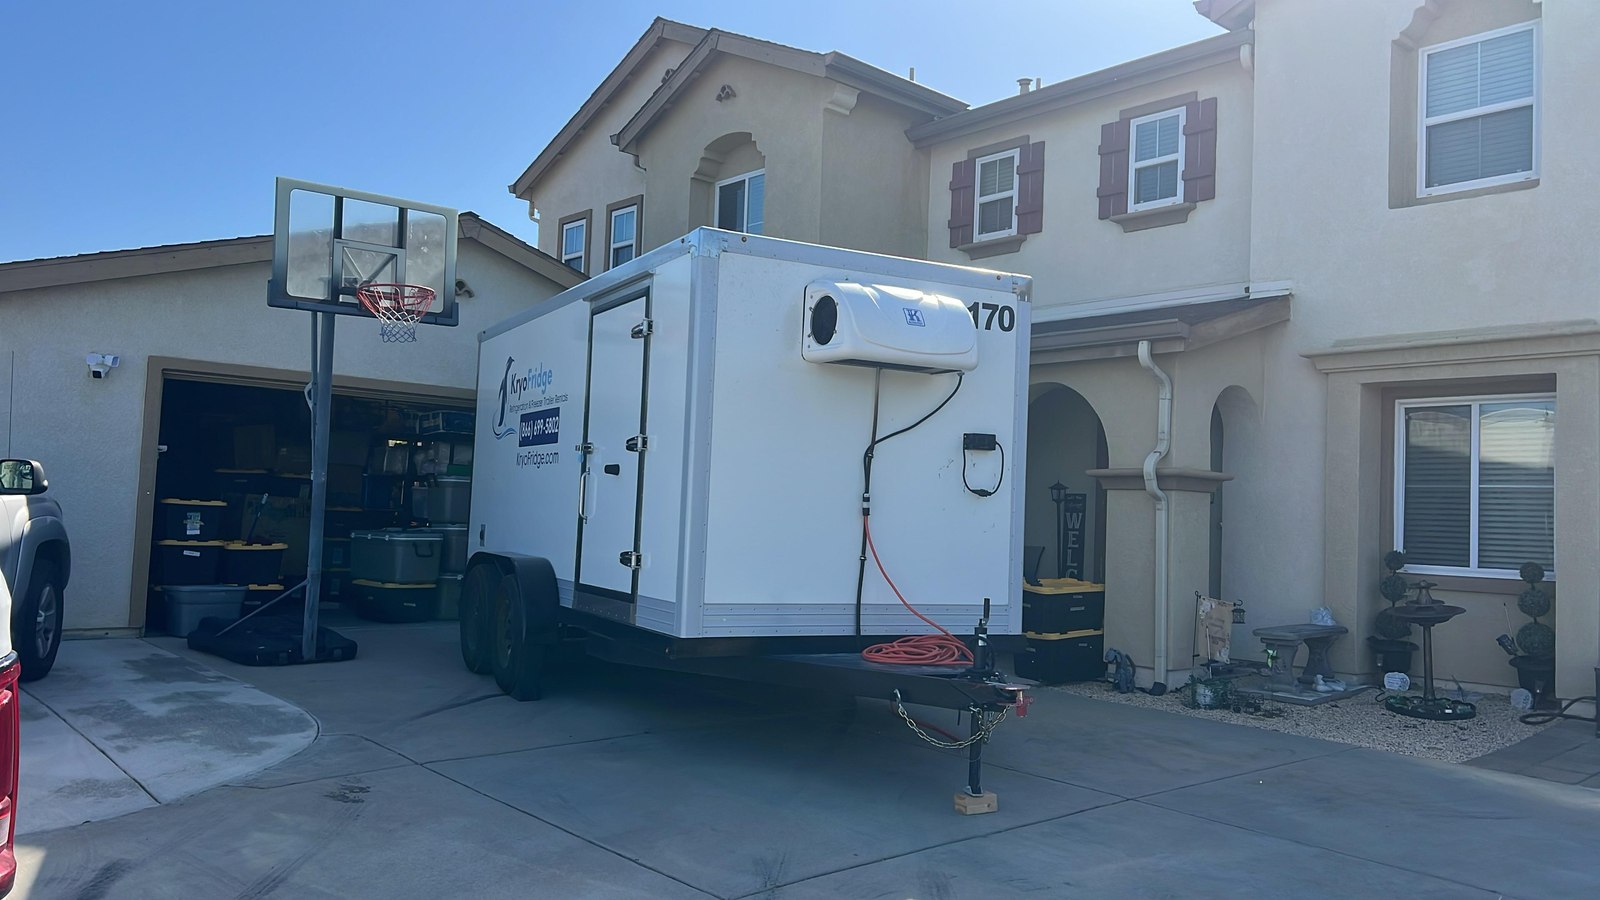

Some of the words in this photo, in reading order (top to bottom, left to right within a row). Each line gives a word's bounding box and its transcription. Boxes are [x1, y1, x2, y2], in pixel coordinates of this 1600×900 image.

[966, 302, 1015, 332] 170
[511, 362, 552, 400] KryoFridge
[520, 420, 533, 441] (866)
[533, 417, 559, 435] 699-5802
[516, 450, 559, 468] KryoFridge.com
